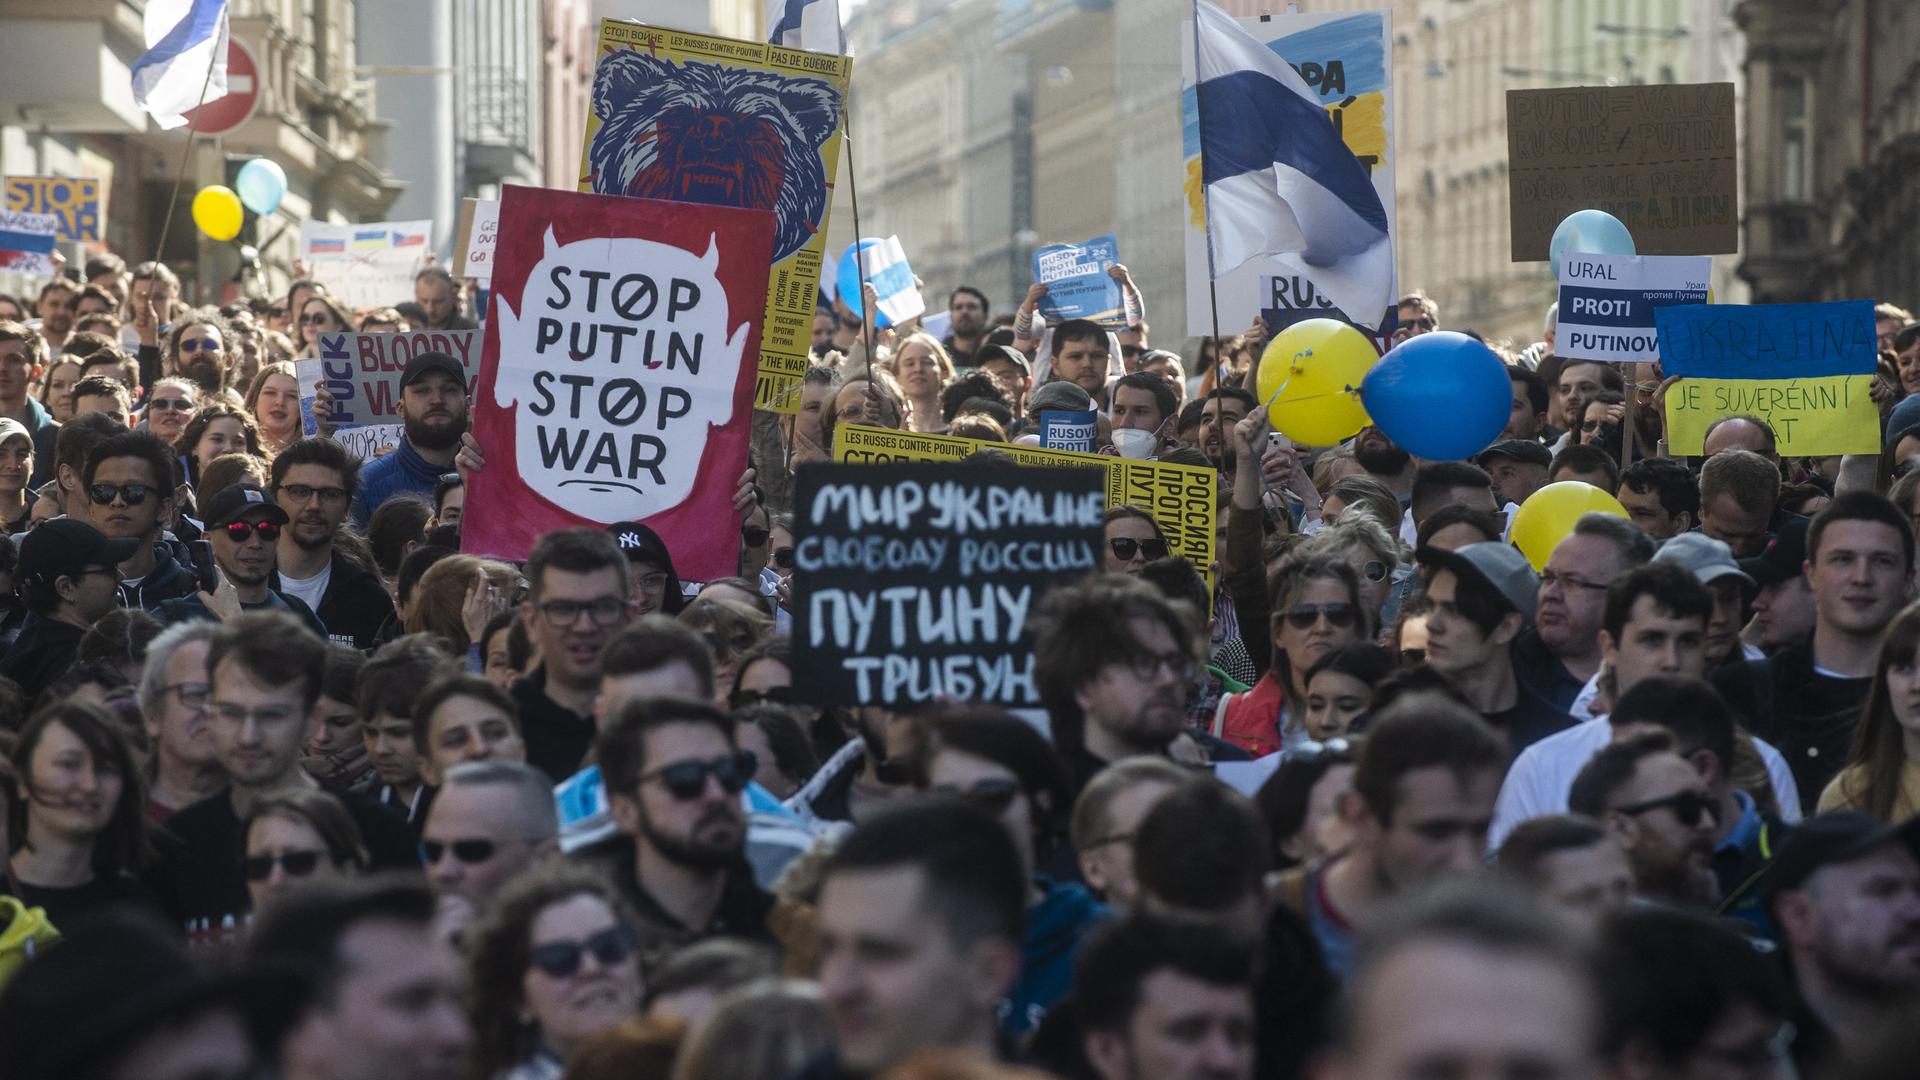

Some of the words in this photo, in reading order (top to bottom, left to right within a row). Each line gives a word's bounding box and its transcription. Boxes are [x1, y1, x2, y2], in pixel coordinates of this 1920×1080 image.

[670, 36, 683, 46] LES
[684, 38, 709, 50] RUSSES
[710, 41, 735, 55] CONTRE
[736, 45, 762, 59] POUTINE
[771, 51, 787, 65] PAS
[789, 54, 801, 67] DE
[803, 56, 838, 72] GUERRE
[6, 178, 98, 214] STOP
[57, 208, 98, 240] AR
[796, 259, 821, 268] AGAINST
[1568, 261, 1617, 280] URAL
[775, 269, 789, 307] РОССИЯНЕ
[788, 281, 801, 309] ПРОТИВ
[801, 283, 813, 311] ПУТИНА
[1643, 291, 1673, 300] против
[1674, 290, 1706, 300] Путина
[1685, 281, 1706, 290] Урал
[1572, 297, 1631, 317] PROTI
[357, 333, 473, 372] BLOODY
[536, 317, 703, 375] PUTIN
[1664, 317, 1874, 362] UKRAJINA
[321, 334, 355, 422] FUCK
[766, 355, 782, 368] THE
[785, 358, 805, 372] WAR
[1675, 385, 1701, 410] JE
[1715, 375, 1851, 411] SUVERÉNNÍ
[537, 425, 666, 485] WAR
[846, 432, 861, 444] LES
[863, 435, 897, 448] RUSSES
[898, 439, 932, 453] CONTRE
[934, 443, 969, 457] POUTINE
[1020, 455, 1046, 466] BOJUJE
[1047, 457, 1056, 467] ZA
[811, 481, 924, 531] МИР
[928, 481, 1105, 533] УКРАИНЕ
[796, 535, 948, 571] СВОБОДУ
[960, 540, 1096, 576] РОССИИ
[811, 583, 1031, 653] ПУТИНУ
